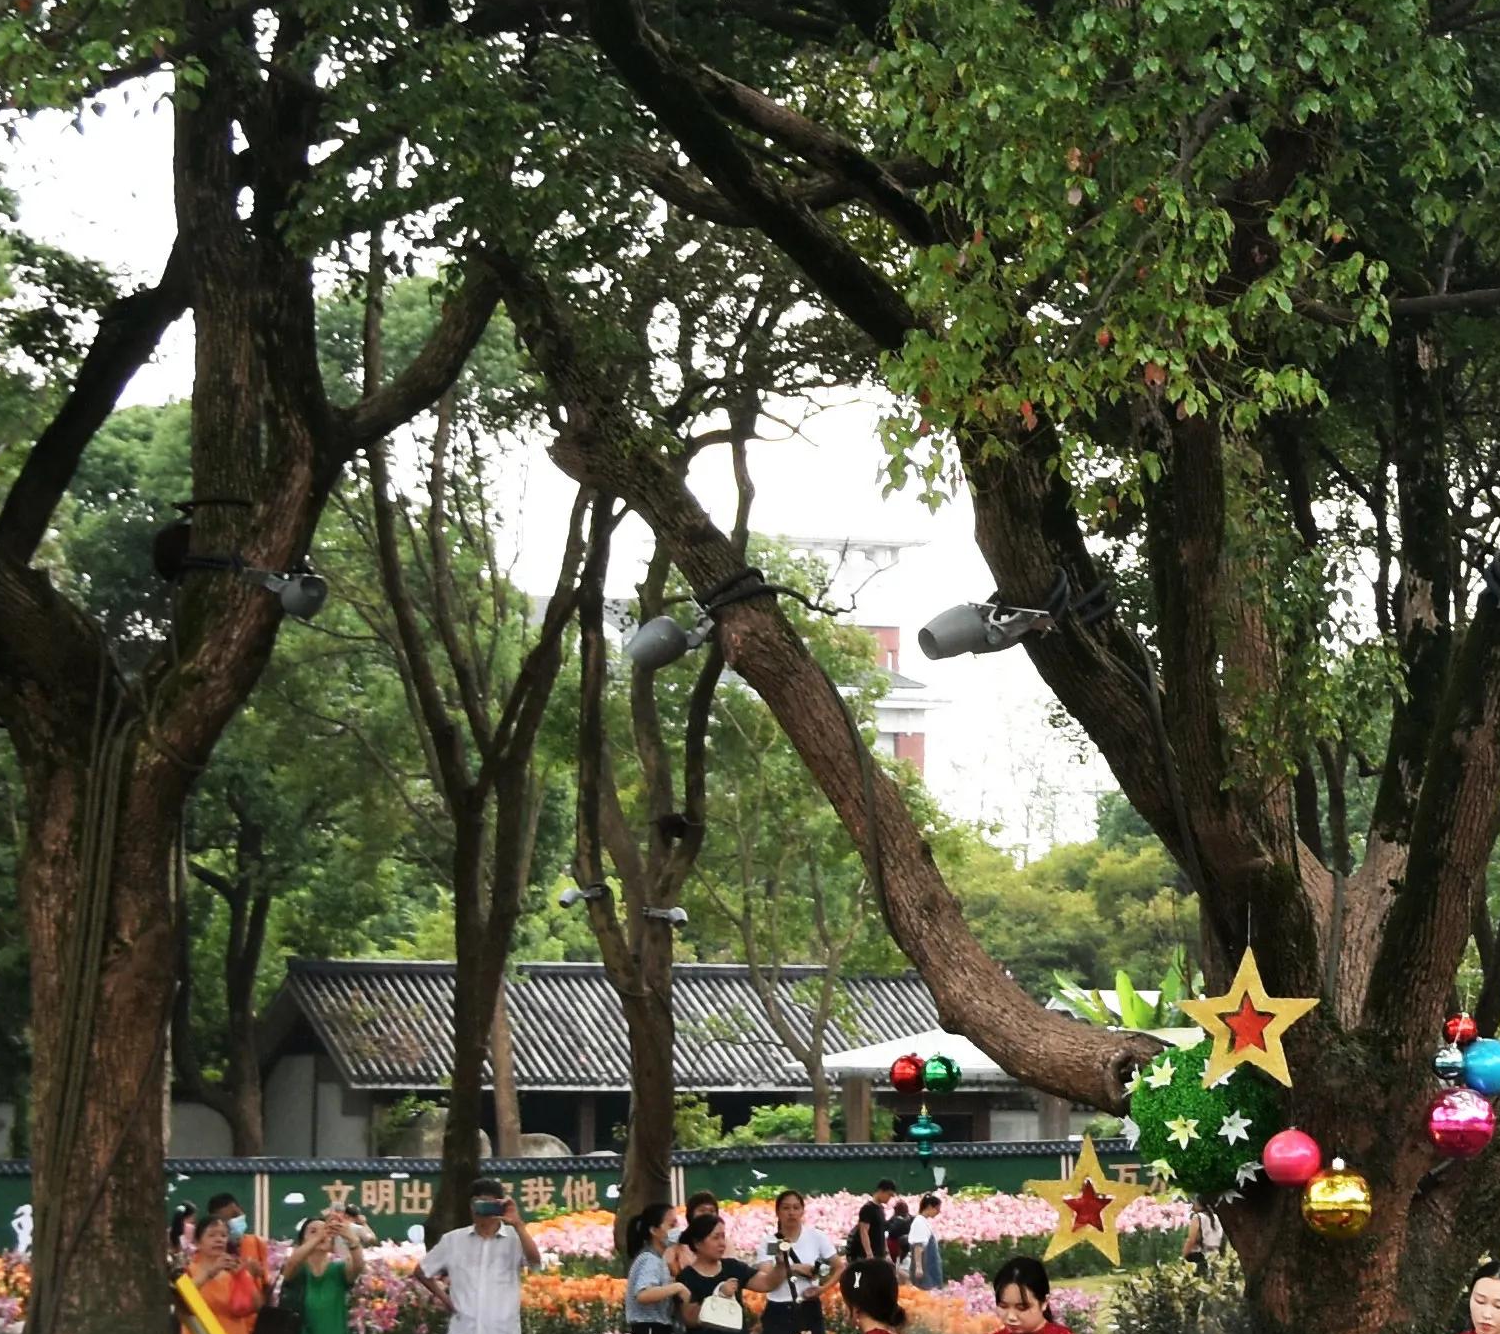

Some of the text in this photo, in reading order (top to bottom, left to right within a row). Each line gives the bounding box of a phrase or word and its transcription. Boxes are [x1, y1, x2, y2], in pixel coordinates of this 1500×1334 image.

[321, 1175, 600, 1215] 文明出我他
